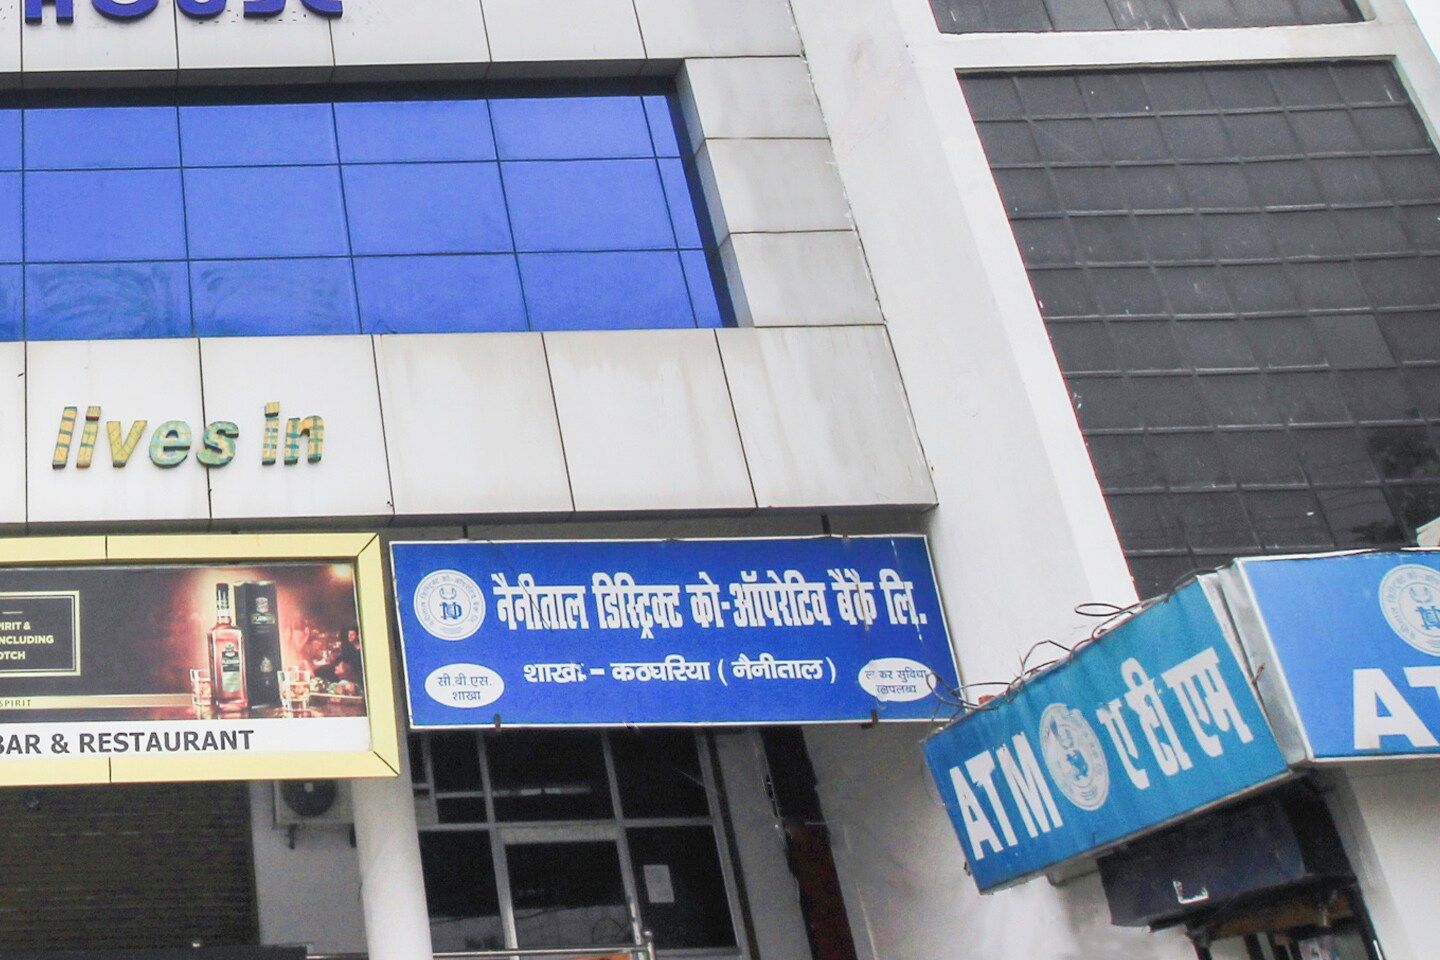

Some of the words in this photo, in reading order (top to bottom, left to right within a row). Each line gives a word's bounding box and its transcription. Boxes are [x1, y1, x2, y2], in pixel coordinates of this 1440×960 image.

[53, 406, 239, 470] lives
[262, 402, 325, 466] in
[491, 572, 589, 630] नैनीताल
[879, 568, 928, 625] लि.
[24, 622, 31, 630] &
[610, 654, 710, 683] कठघरिया
[0, 699, 31, 707] SPIRIT
[51, 733, 70, 754] &
[79, 730, 254, 753] RESTAURANT
[949, 731, 1063, 861] ATM
